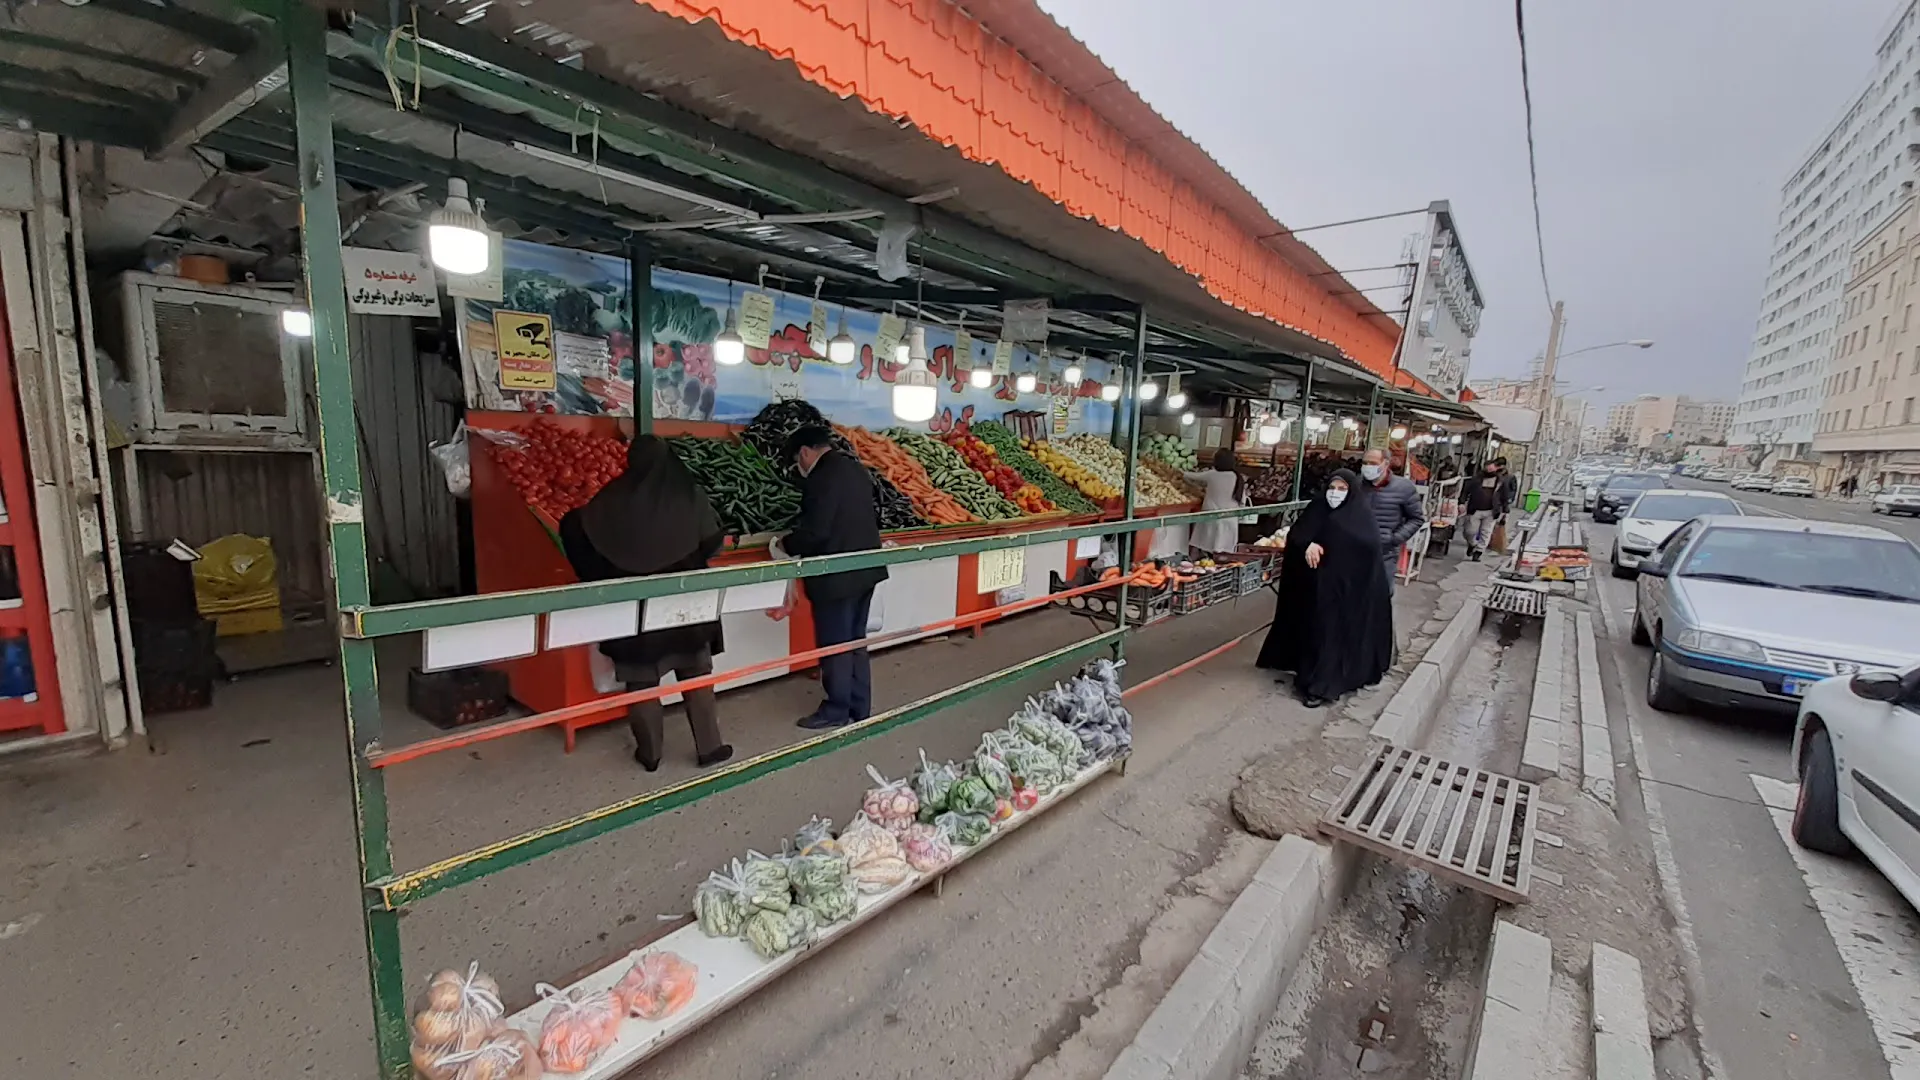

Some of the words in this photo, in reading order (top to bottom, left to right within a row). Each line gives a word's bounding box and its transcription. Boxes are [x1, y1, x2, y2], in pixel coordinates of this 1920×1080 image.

[364, 268, 372, 279] ۵
[373, 270, 397, 281] شماره
[399, 271, 417, 284] غرفه
[387, 289, 404, 306] برگی
[405, 291, 435, 307] سبزیجات
